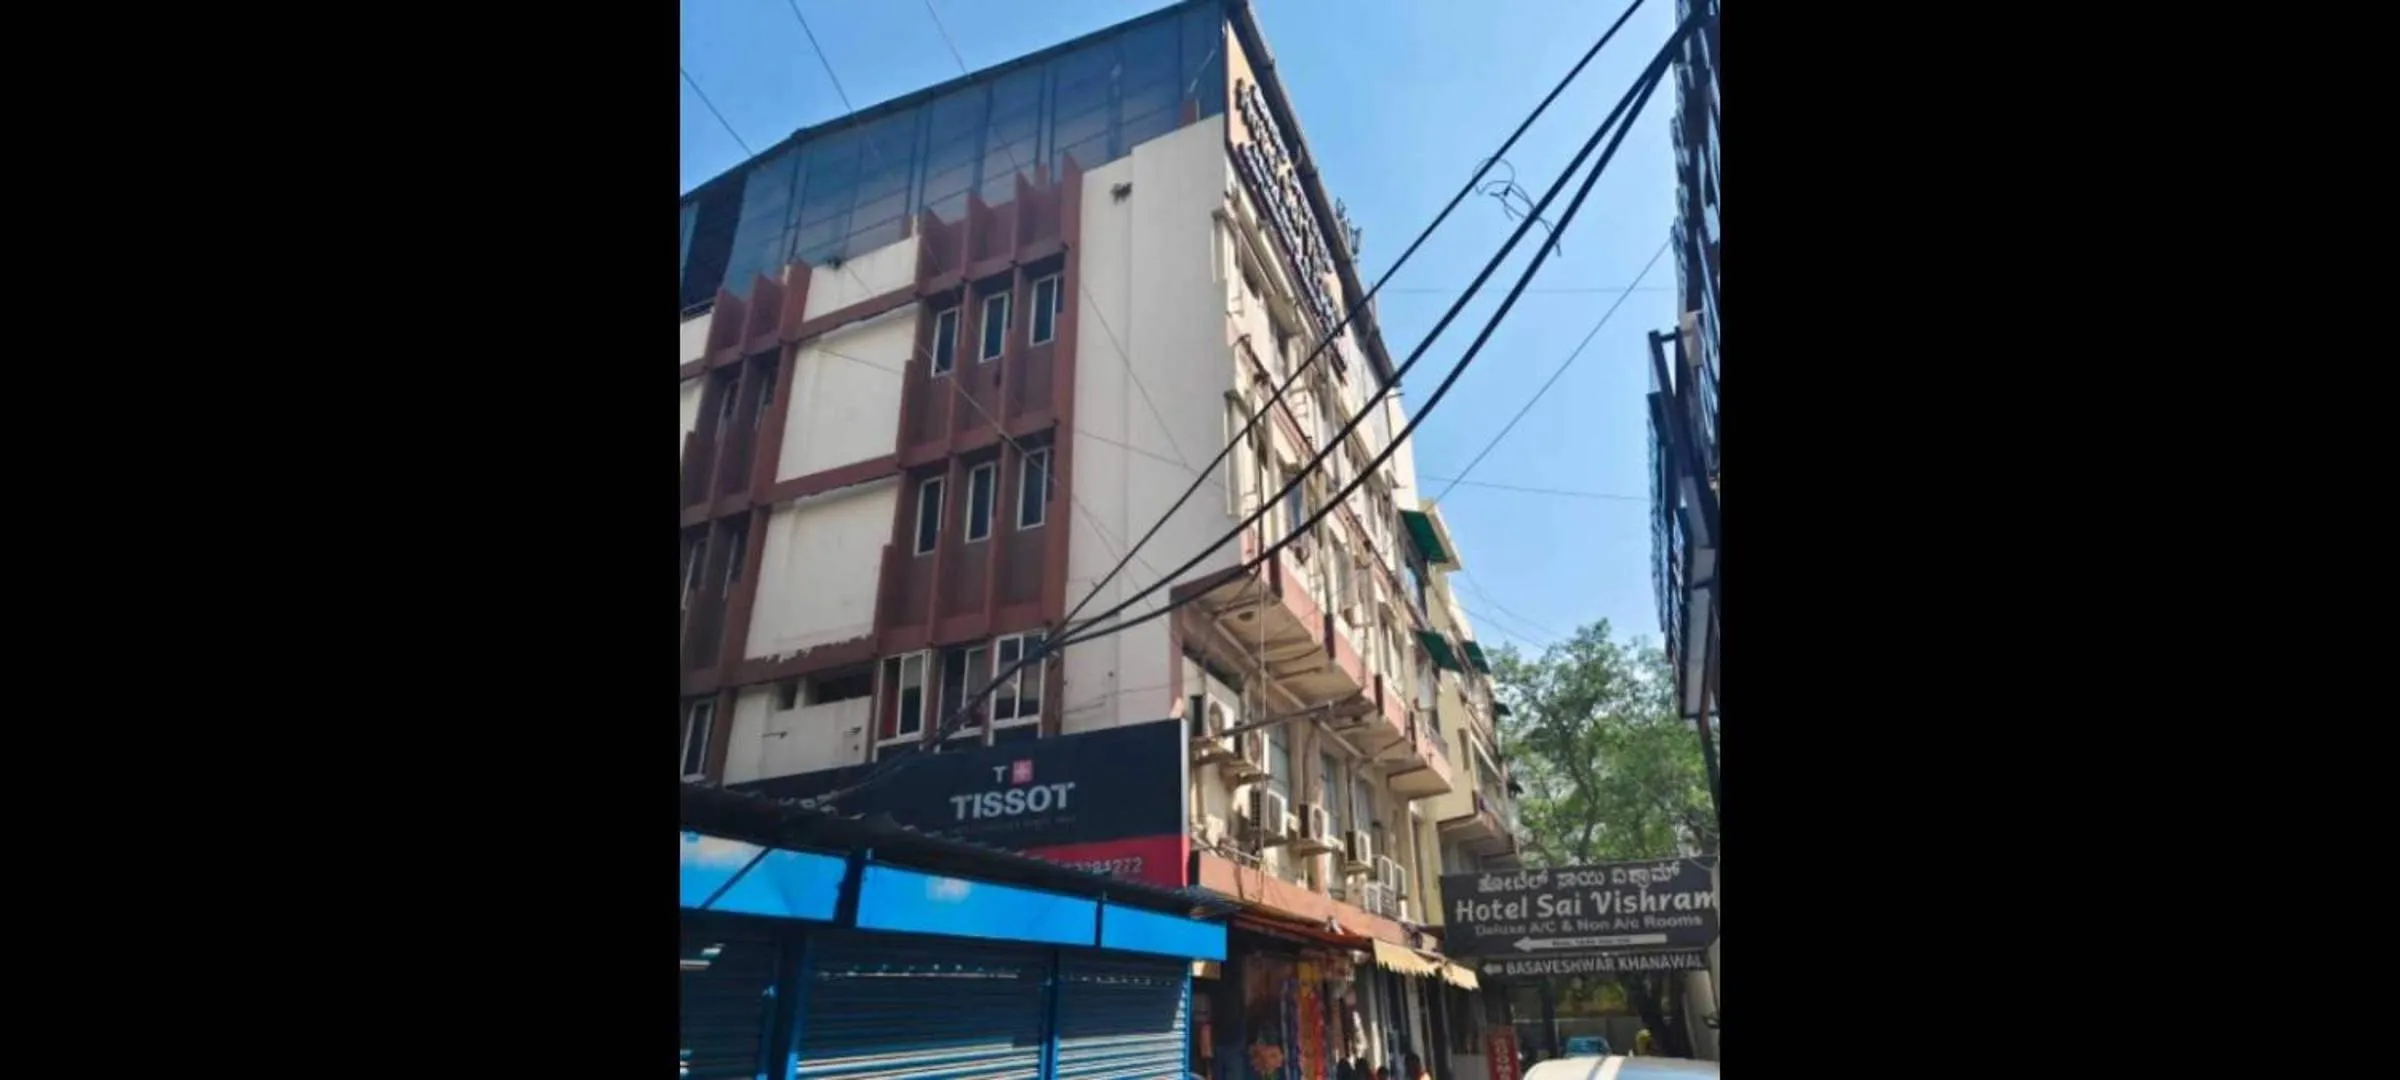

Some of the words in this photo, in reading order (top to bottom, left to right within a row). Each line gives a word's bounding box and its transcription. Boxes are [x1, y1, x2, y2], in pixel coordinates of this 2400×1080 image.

[949, 781, 1076, 820] TISSOT
[1455, 895, 1529, 923] Hotel
[1536, 890, 1583, 919] Sai
[1590, 888, 1718, 915] Vishram
[1643, 914, 1703, 928] Rooms
[1506, 956, 1615, 976] BASAVESHWAR
[1618, 953, 1704, 971] KHANAWAL
